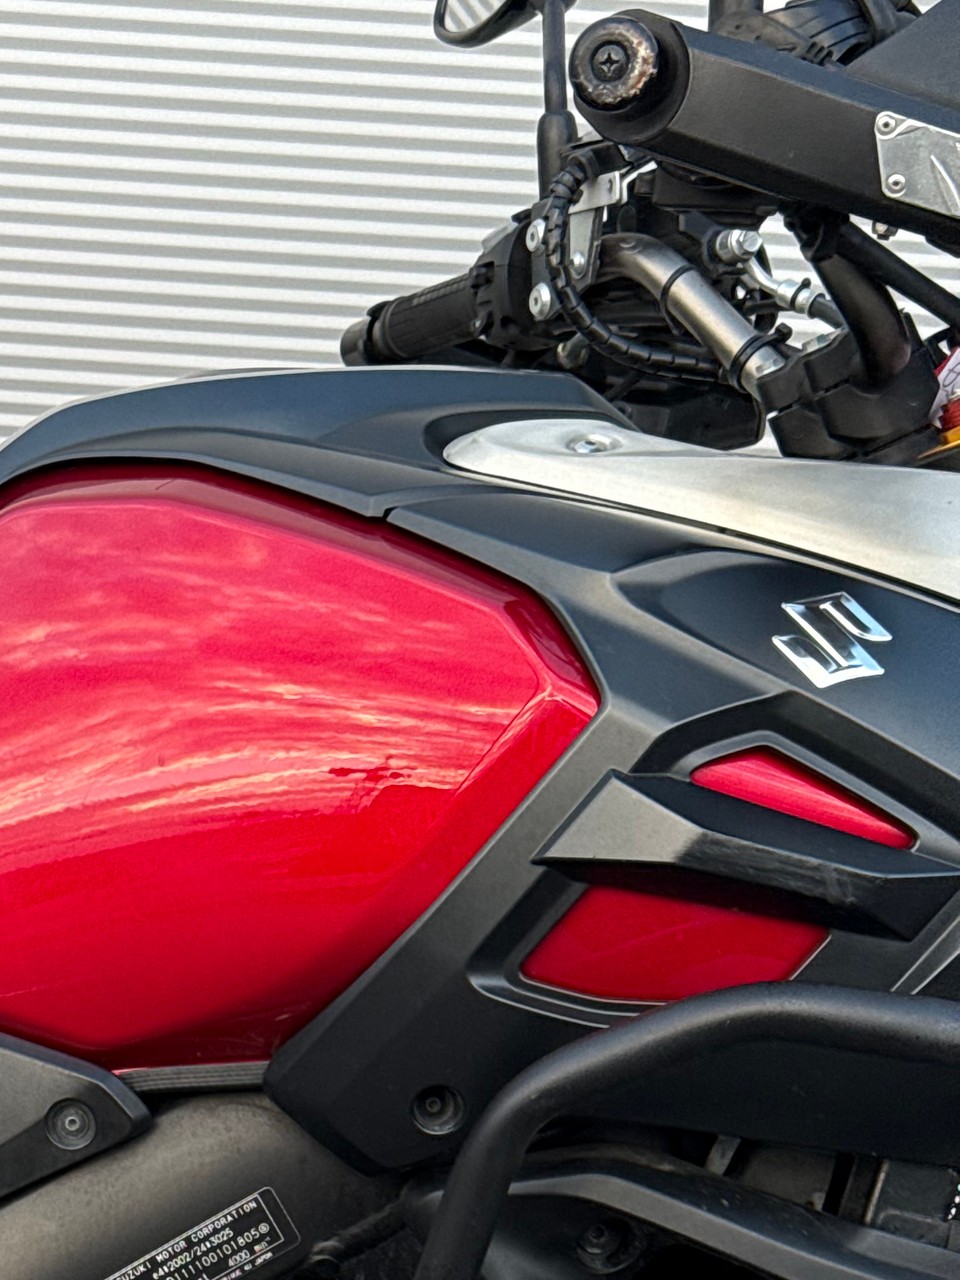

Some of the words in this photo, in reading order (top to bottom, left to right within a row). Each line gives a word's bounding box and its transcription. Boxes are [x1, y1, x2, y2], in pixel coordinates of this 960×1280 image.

[155, 1240, 187, 1263] MOTOR
[191, 1200, 257, 1242] CORPORATION
[228, 1249, 250, 1267] 4000
